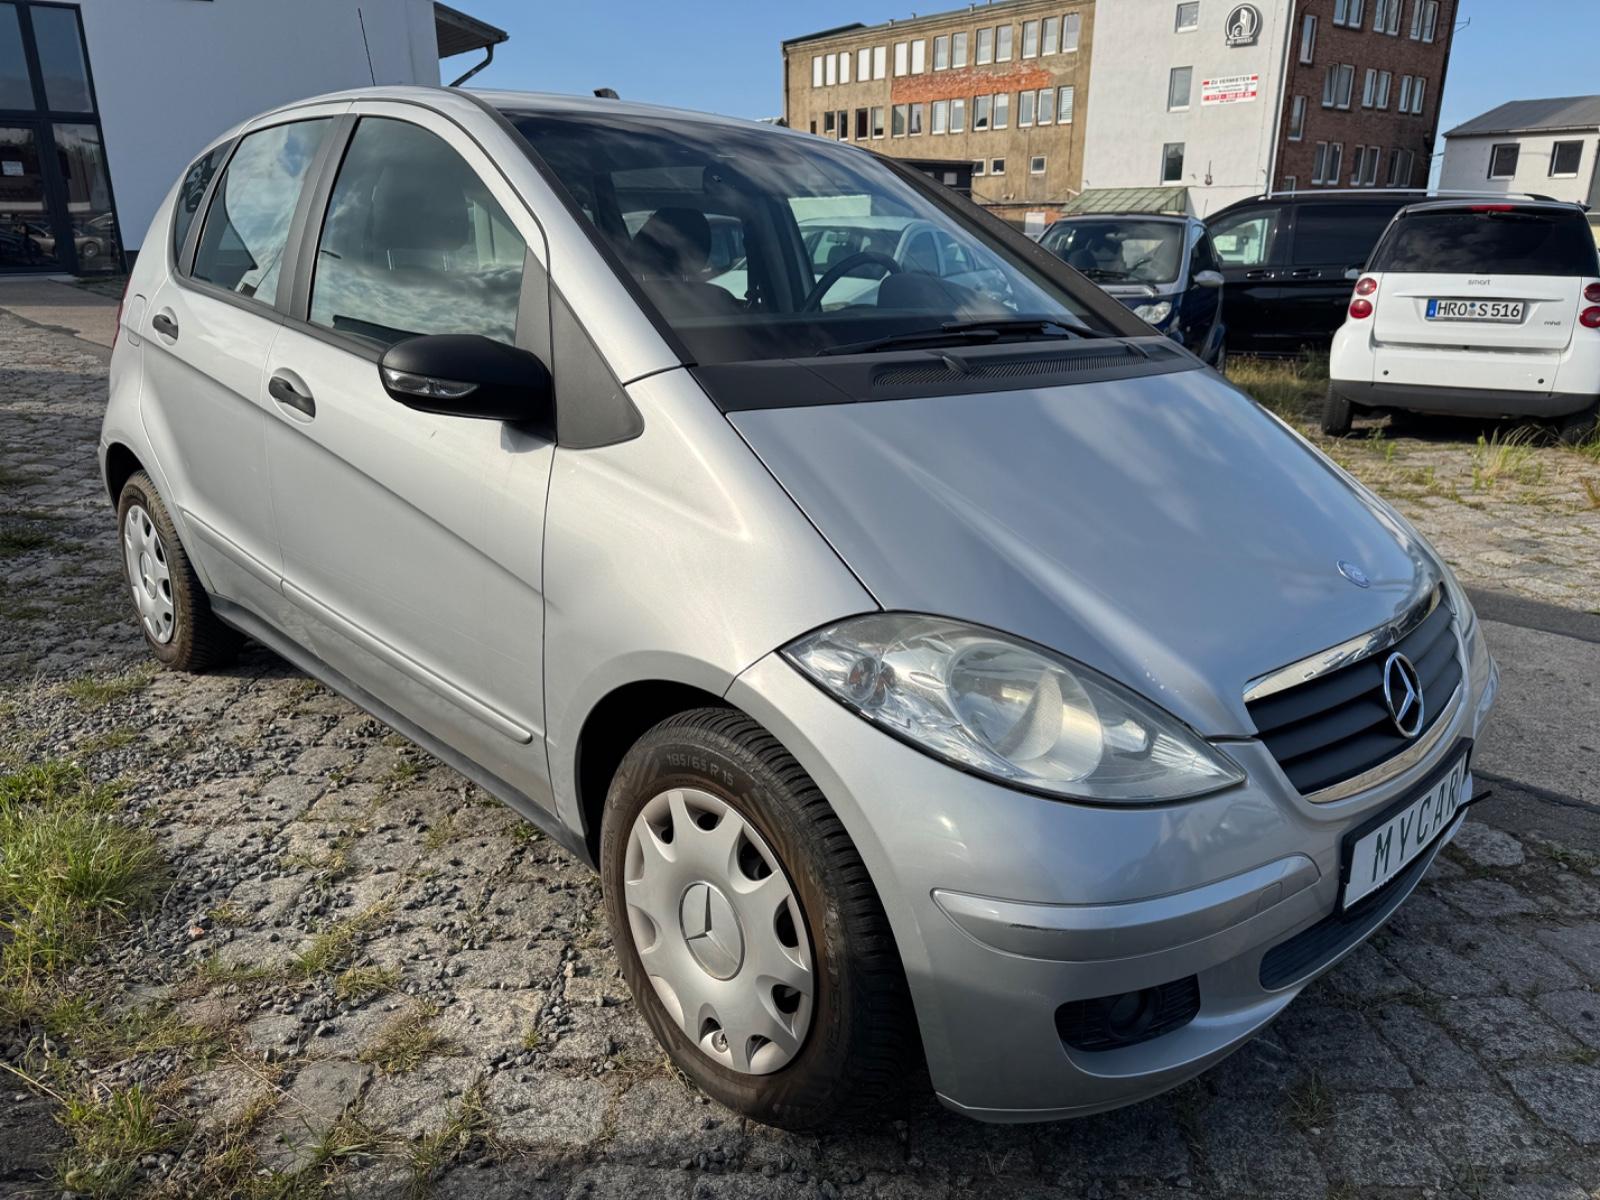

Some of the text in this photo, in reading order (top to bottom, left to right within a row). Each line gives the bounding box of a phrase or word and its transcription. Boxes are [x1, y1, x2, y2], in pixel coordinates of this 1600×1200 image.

[1437, 301, 1520, 318] HRO S 516
[667, 752, 707, 771] 185/65
[723, 770, 734, 786] 15
[1372, 768, 1459, 882] MYCAR
